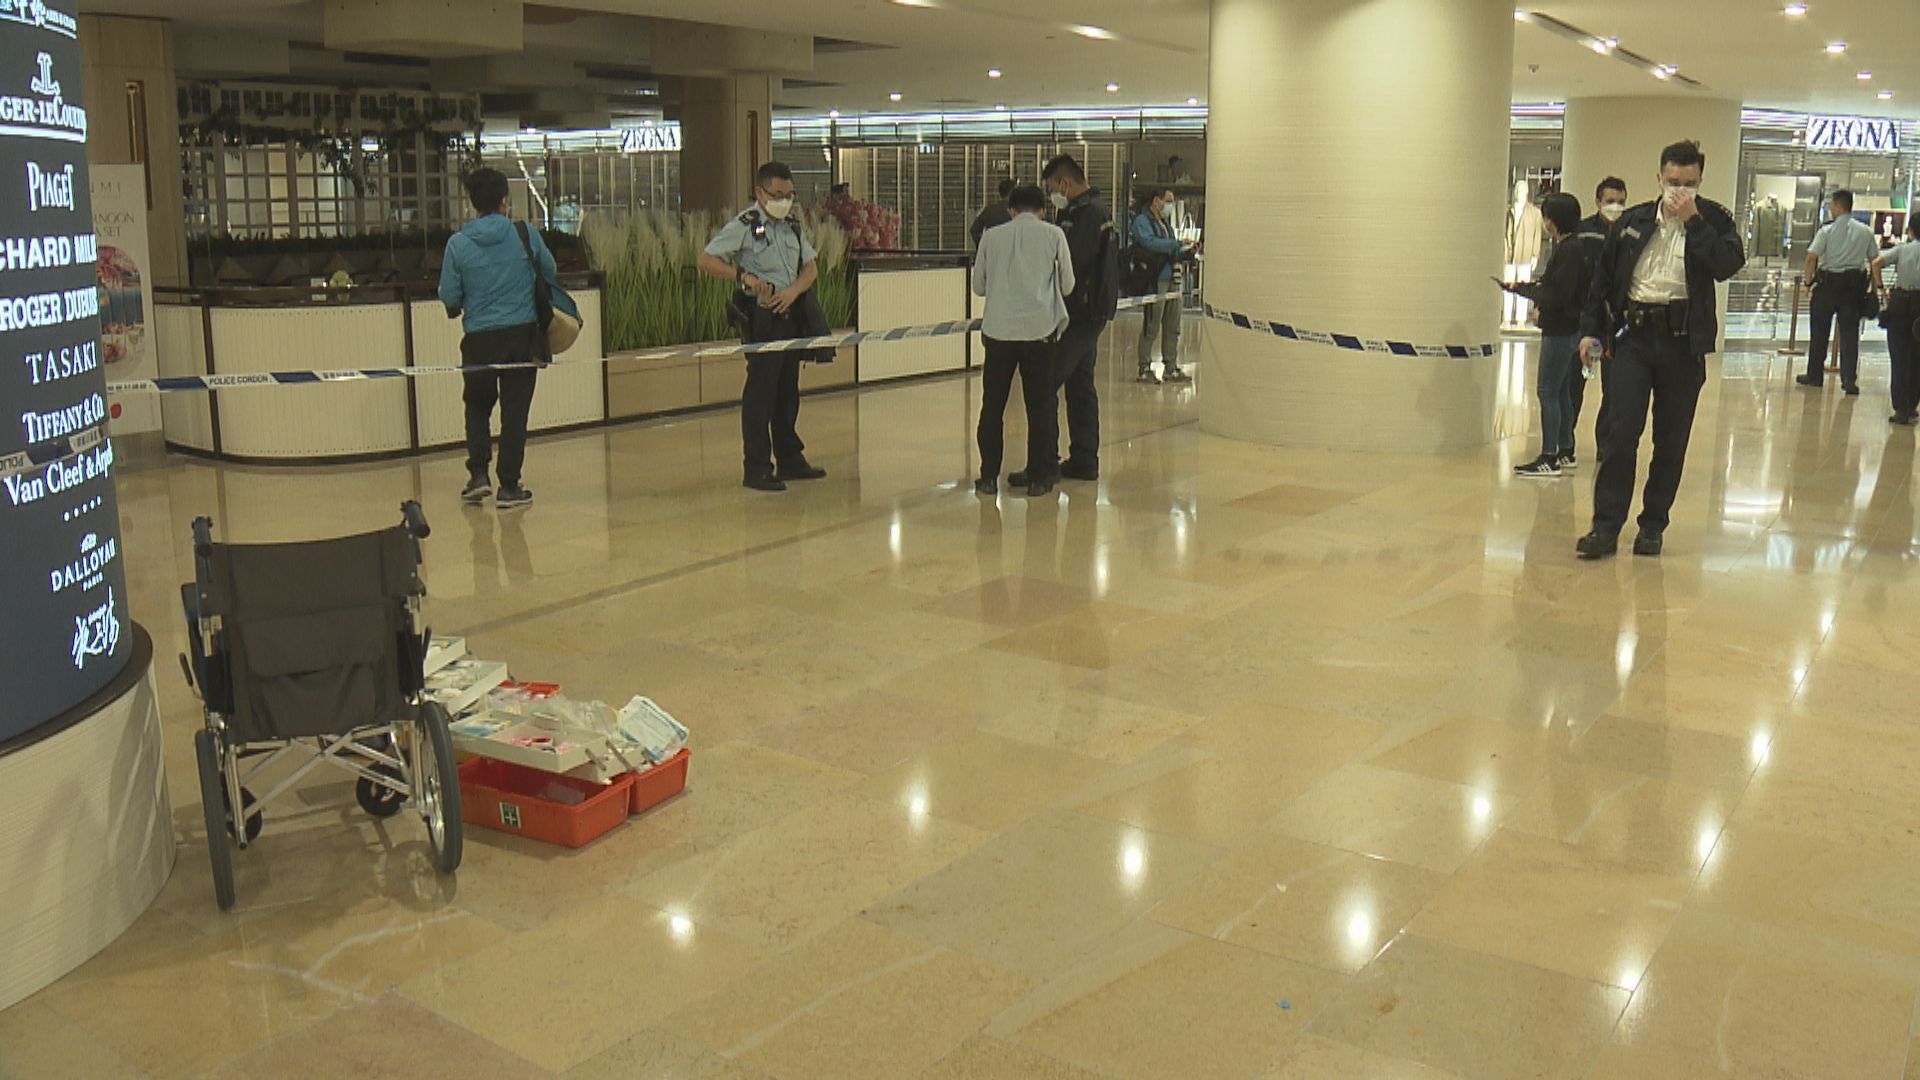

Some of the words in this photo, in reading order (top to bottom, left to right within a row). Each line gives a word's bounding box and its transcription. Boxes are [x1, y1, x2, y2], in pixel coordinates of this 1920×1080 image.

[621, 127, 677, 149] ZEGNA
[1811, 118, 1898, 148] ZEGNA
[27, 161, 74, 211] PIAGET
[0, 293, 62, 331] ROGER
[26, 340, 97, 385] TASAKI
[4, 474, 45, 506] Van
[46, 454, 84, 493] Cleef
[86, 455, 95, 479] &
